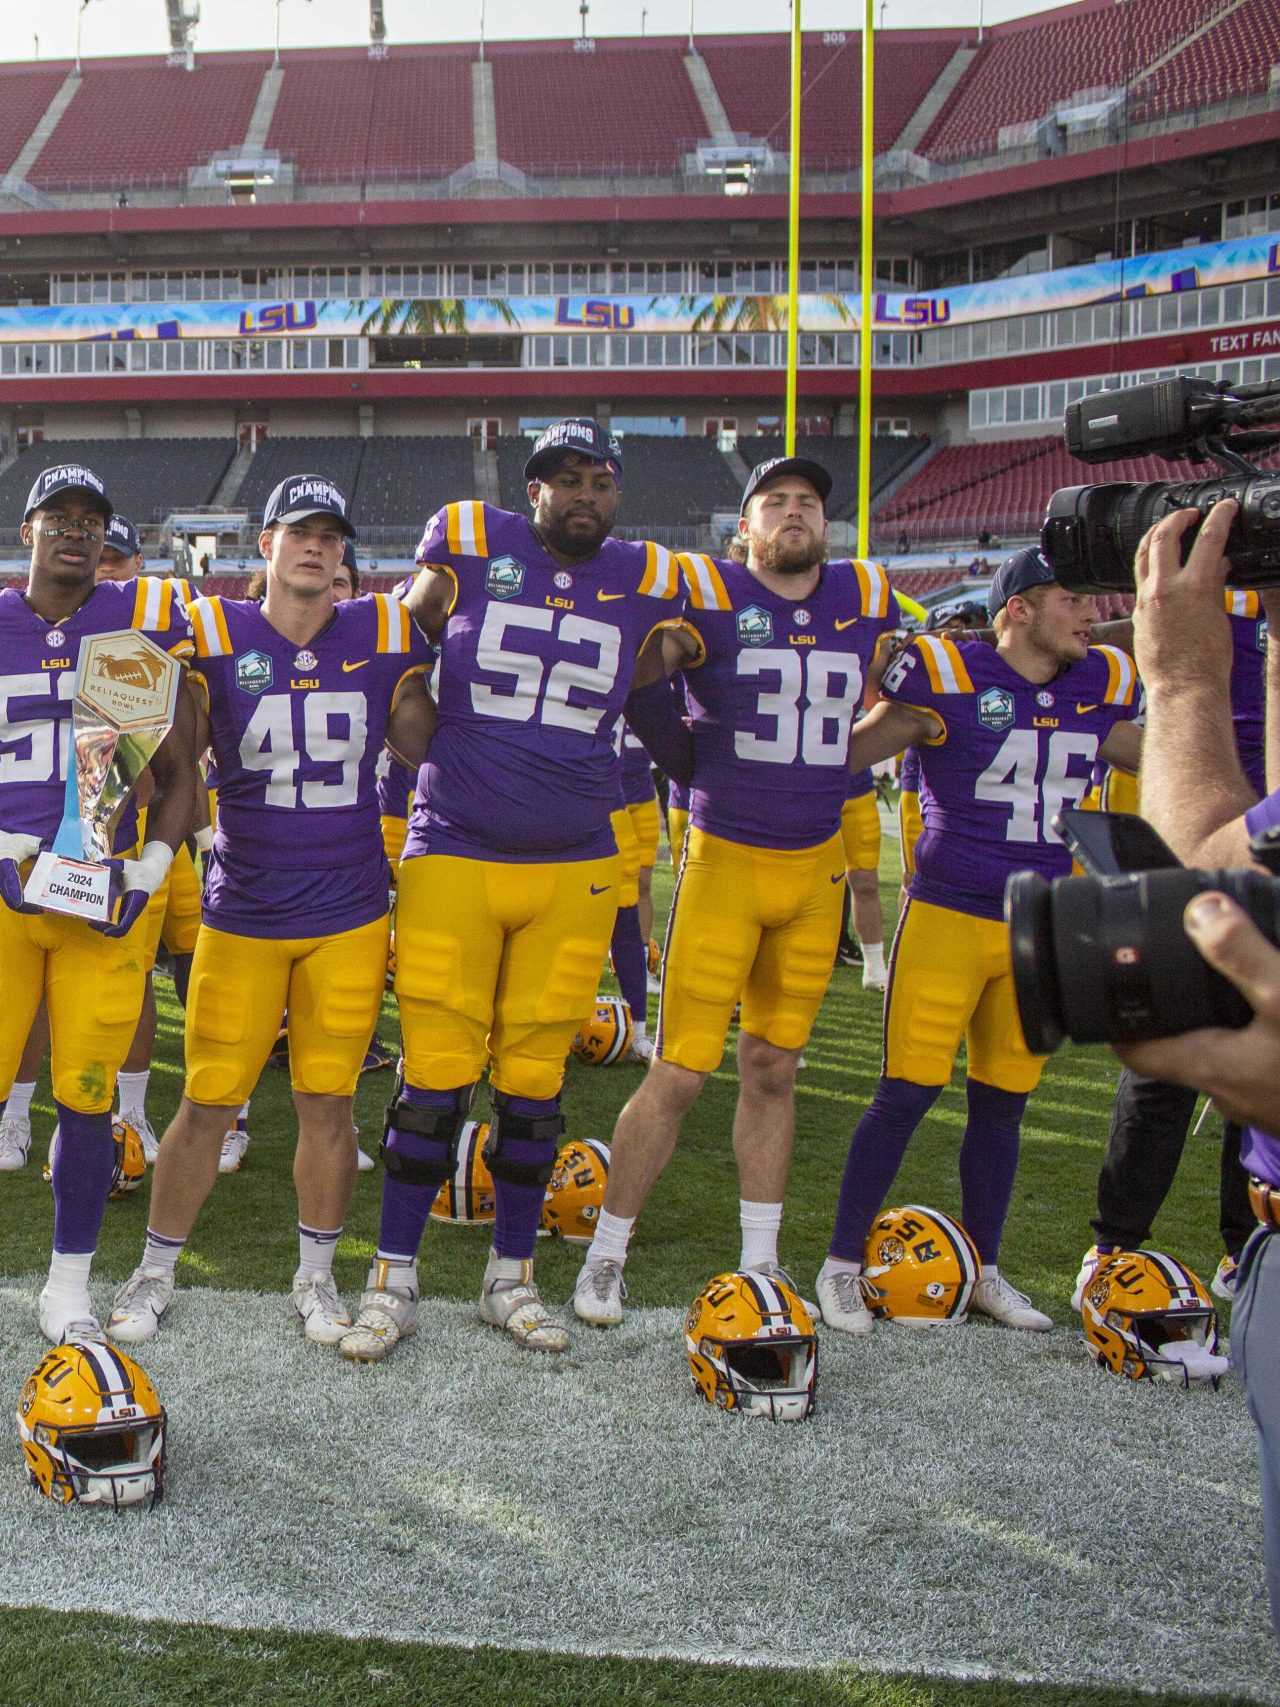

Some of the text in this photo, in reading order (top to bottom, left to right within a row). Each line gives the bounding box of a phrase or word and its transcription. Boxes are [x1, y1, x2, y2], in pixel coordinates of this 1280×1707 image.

[556, 297, 635, 329] LSU
[874, 292, 950, 325] LSU
[239, 301, 318, 334] LSU
[1210, 333, 1248, 352] TEXT
[545, 595, 575, 609] LSU
[46, 630, 65, 647] SEC
[788, 634, 816, 645] LSU
[42, 657, 71, 669] LSU
[470, 600, 621, 734] 52
[290, 679, 320, 689] LSU
[89, 685, 153, 707] RELIAQUEST
[112, 699, 136, 711] BOWL
[734, 648, 862, 766] 38
[1032, 716, 1060, 728] LSU
[238, 691, 369, 809] 49
[975, 729, 1099, 844] 46
[67, 872, 93, 887] 2024
[49, 883, 105, 905] CHAMPION
[367, 1293, 400, 1309] LSU
[502, 1287, 536, 1304] LSU
[1179, 1298, 1200, 1308] LSU
[769, 1327, 792, 1337] LSU
[111, 1407, 137, 1420] LSU
